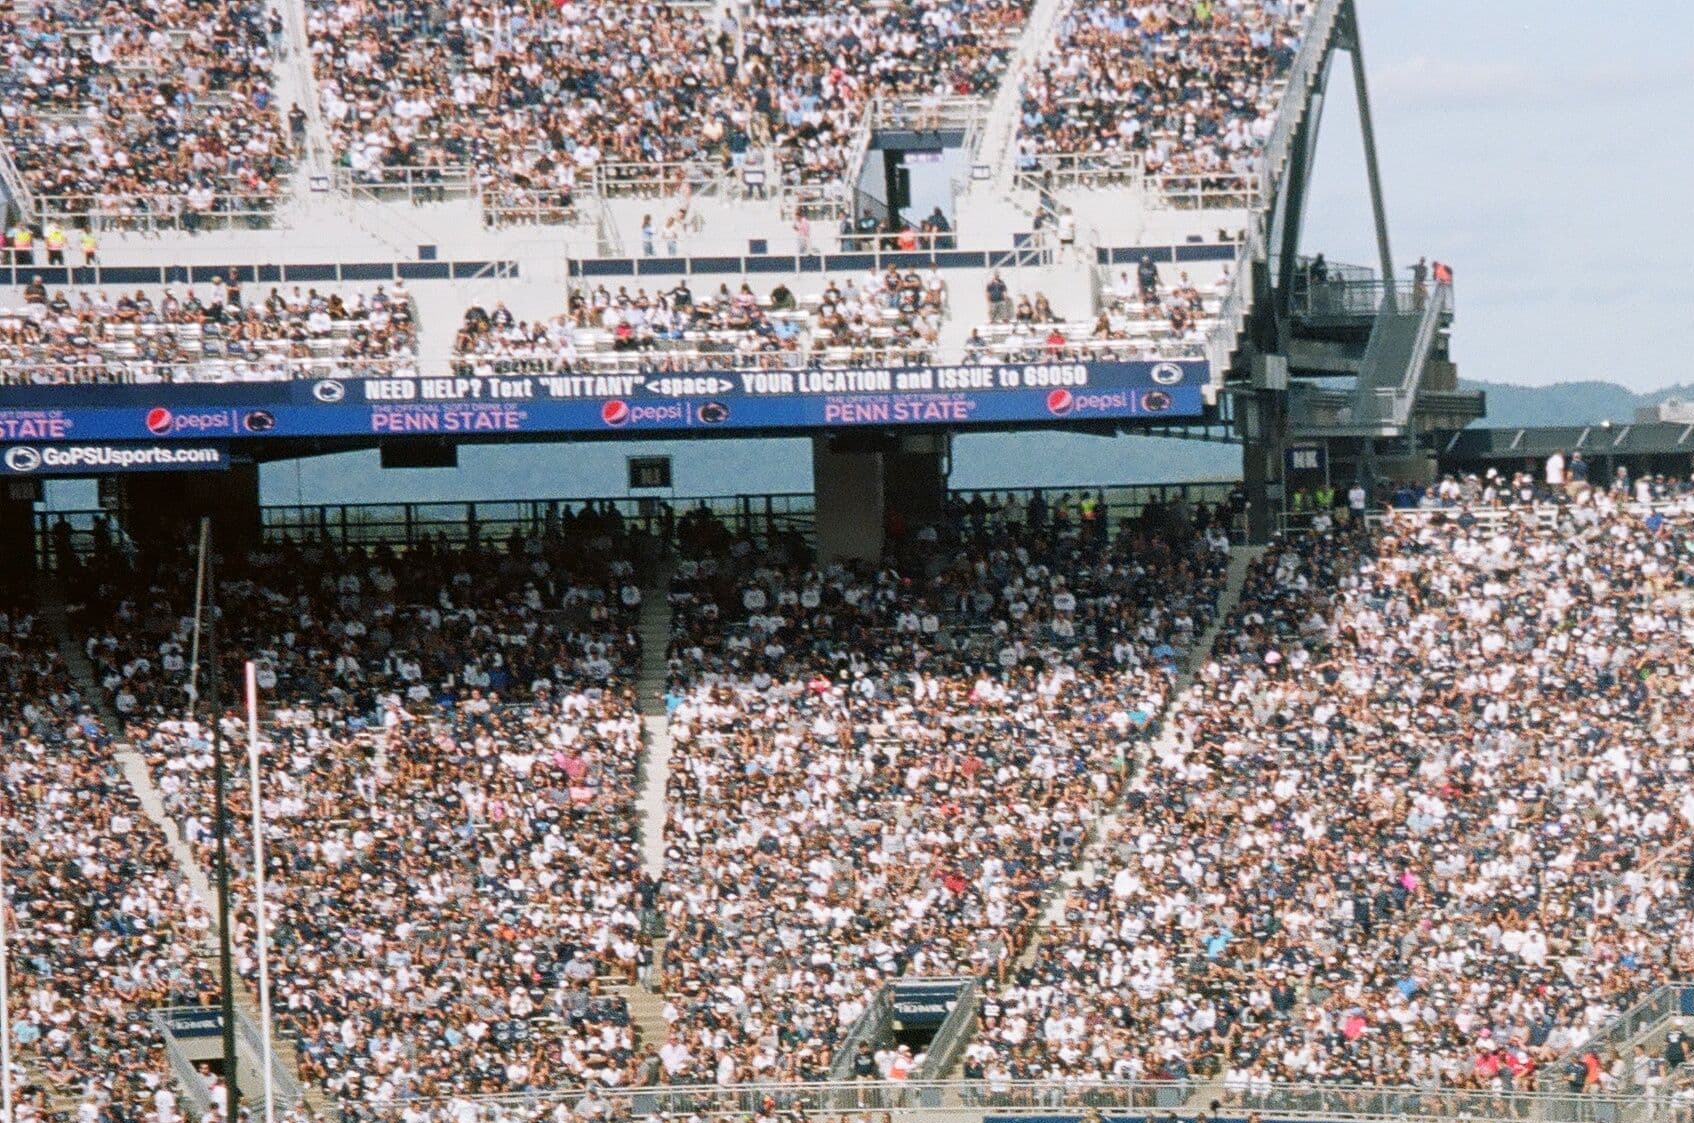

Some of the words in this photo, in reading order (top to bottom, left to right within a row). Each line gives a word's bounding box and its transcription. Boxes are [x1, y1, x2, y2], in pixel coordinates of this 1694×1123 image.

[365, 379, 416, 399] NEED
[421, 378, 482, 398] HELP?
[490, 378, 533, 398] Text
[741, 373, 793, 393] YOUR
[799, 371, 891, 392] LOCATION
[896, 369, 933, 390] and
[938, 367, 993, 389] ISSUE
[998, 367, 1019, 387] to
[1024, 364, 1088, 386] 69050
[1075, 391, 1127, 411] pepsi
[175, 411, 228, 429] pepsi
[372, 413, 440, 431] PENN
[631, 403, 681, 422] pepsi
[825, 403, 888, 422] PENN
[43, 447, 220, 467] GoPSUsports.com
